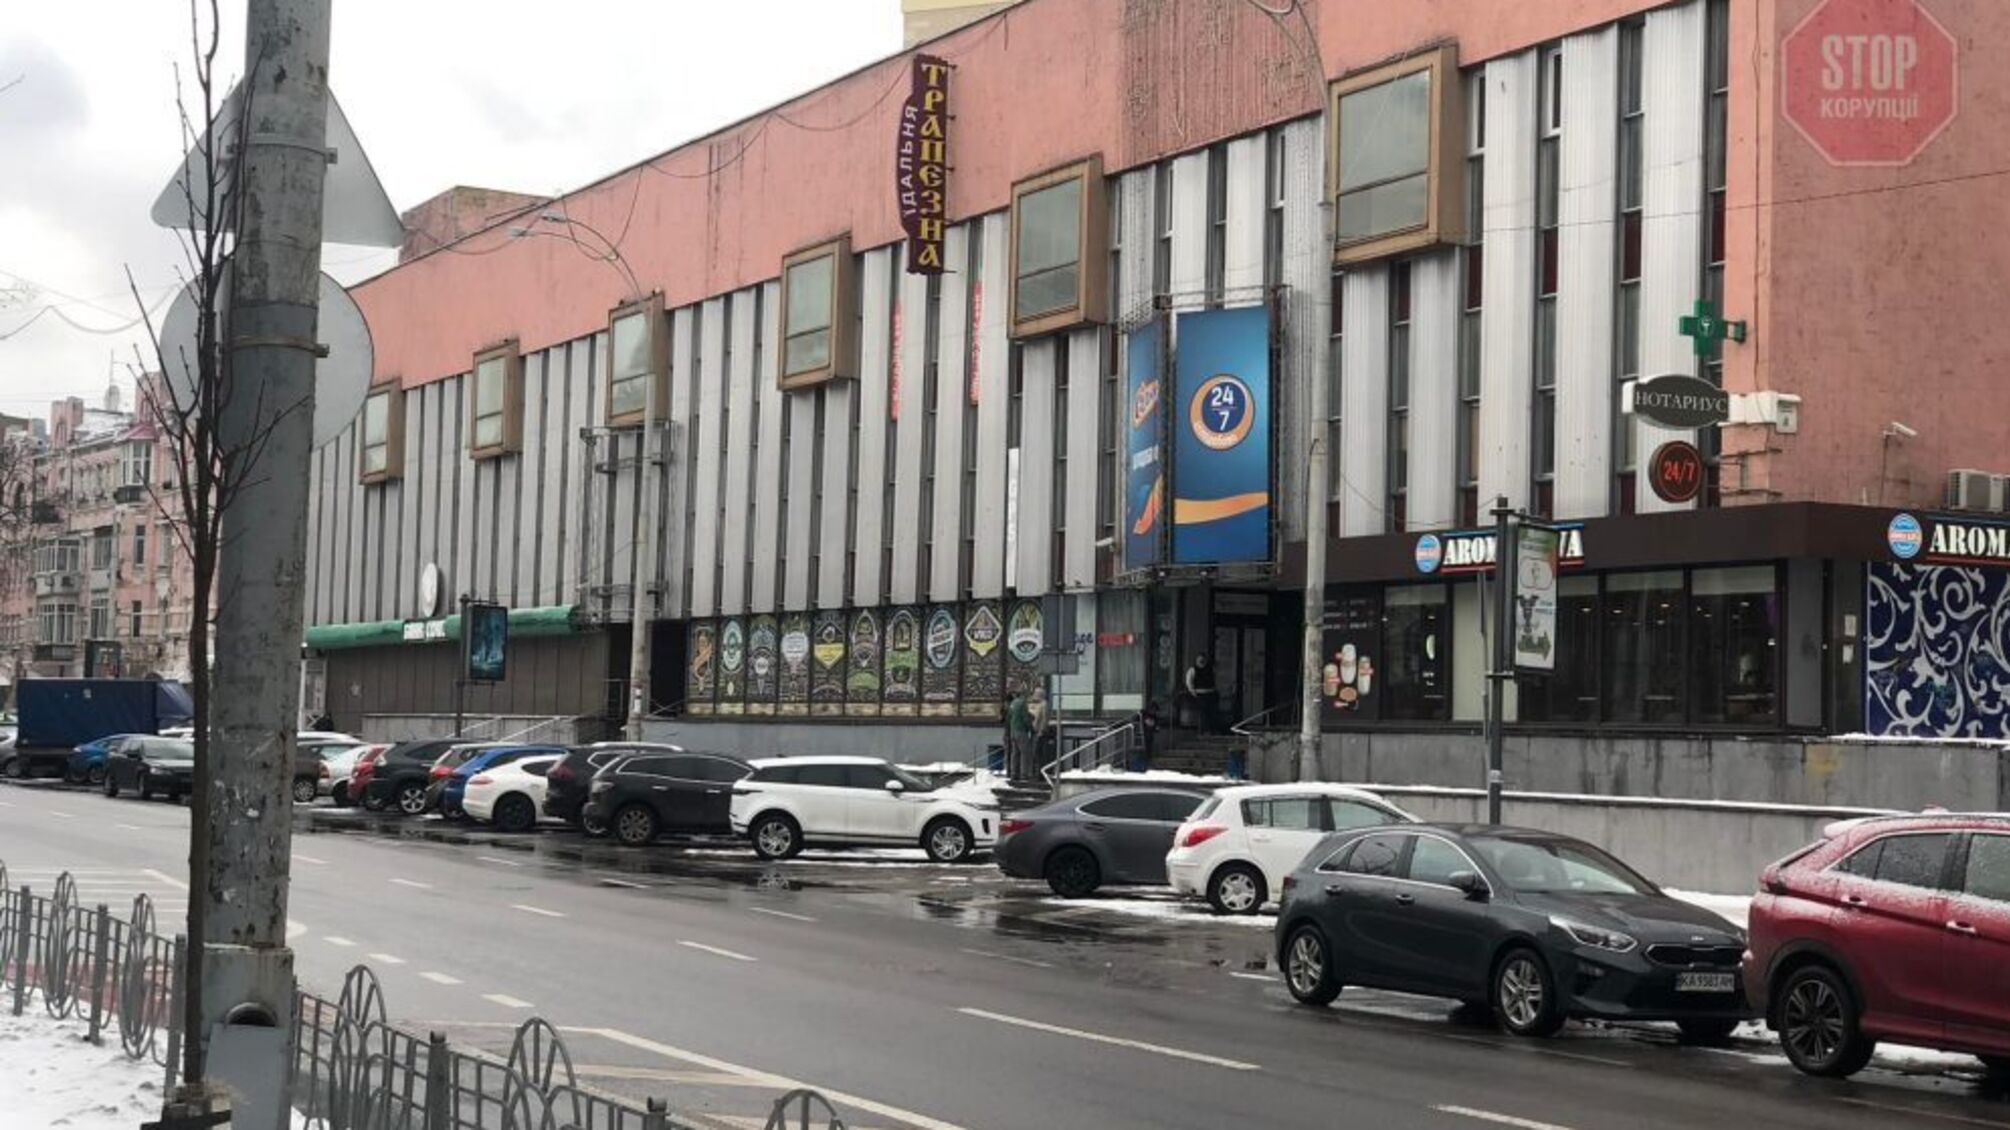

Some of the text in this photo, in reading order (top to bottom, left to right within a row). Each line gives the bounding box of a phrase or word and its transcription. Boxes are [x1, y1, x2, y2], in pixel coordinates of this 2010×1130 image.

[1210, 385, 1234, 407] 24
[1635, 390, 1727, 413] НОТАРИУС
[1219, 410, 1231, 431] 7
[1663, 461, 1696, 484] 24/7
[1442, 536, 1498, 565] AROM
[1928, 523, 2010, 558] AROM
